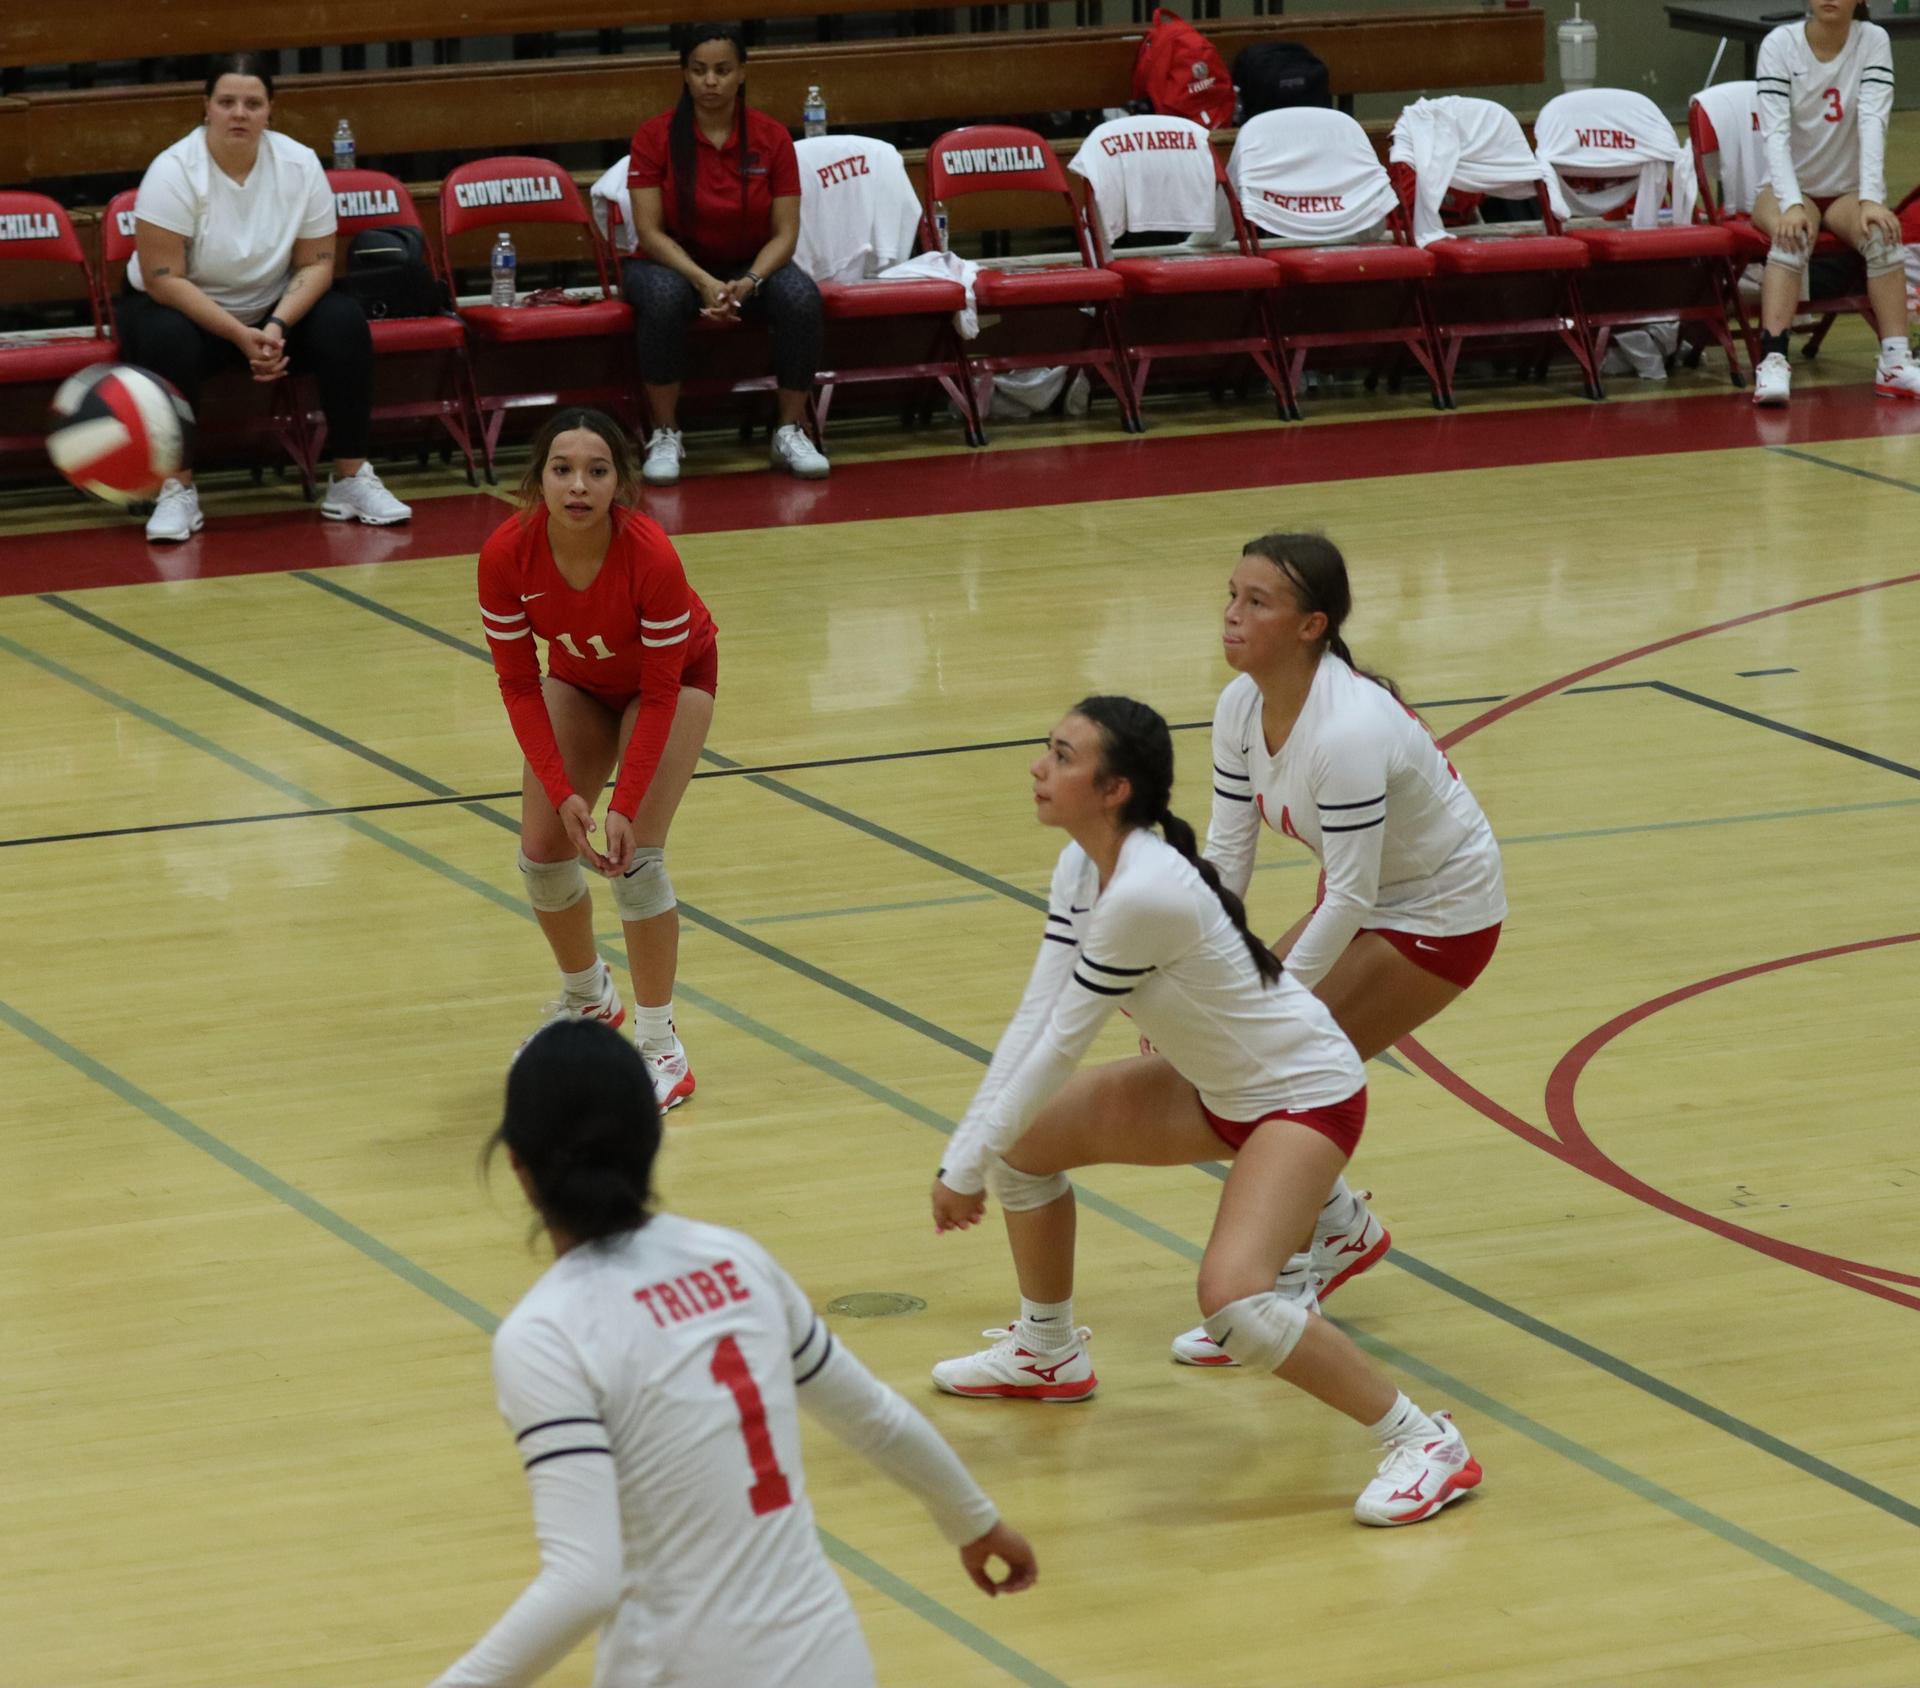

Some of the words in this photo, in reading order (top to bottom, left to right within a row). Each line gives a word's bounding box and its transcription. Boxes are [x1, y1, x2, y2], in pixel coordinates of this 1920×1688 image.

[1822, 87, 1844, 122] 3
[1100, 131, 1197, 157] CHAVARRIA
[1575, 128, 1636, 150] WIENS
[817, 154, 870, 189] PITTZ
[941, 146, 1046, 176] CHOWCHILLA
[454, 176, 563, 209] CHOWCHILLA
[555, 632, 617, 660] 11
[633, 1259, 751, 1329] TRIBE
[709, 1332, 794, 1517] 1
